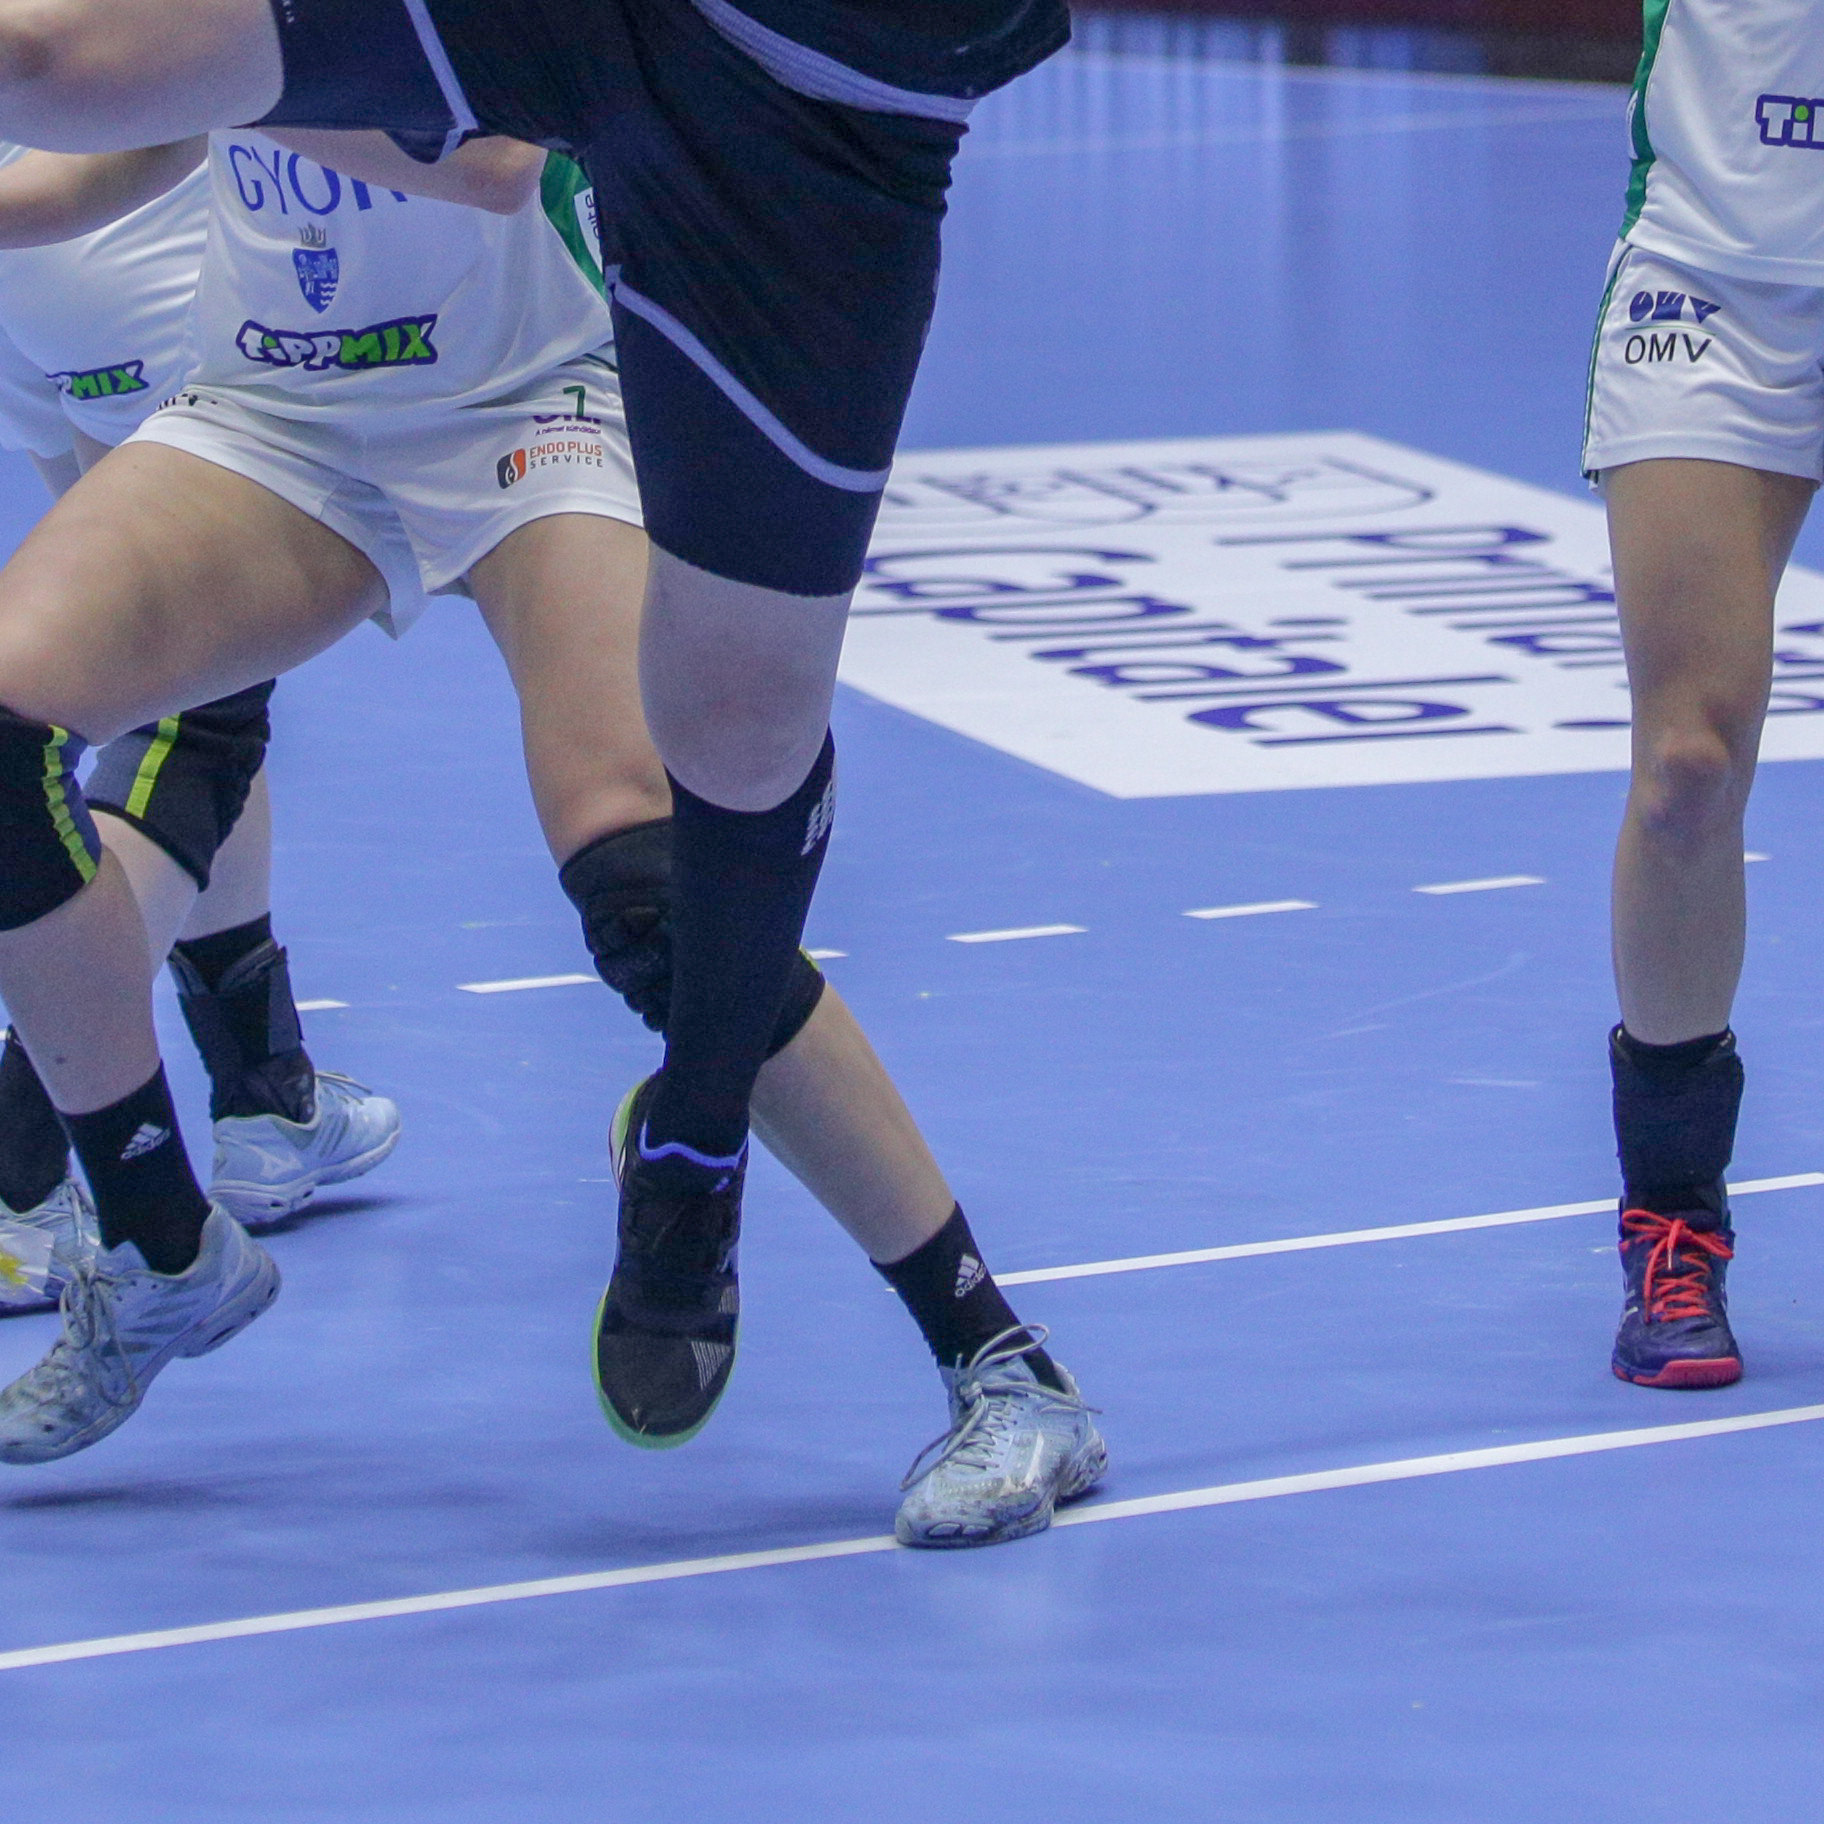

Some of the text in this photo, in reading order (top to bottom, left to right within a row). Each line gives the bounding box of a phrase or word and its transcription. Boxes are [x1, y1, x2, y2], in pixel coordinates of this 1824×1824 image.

[1624, 332, 1713, 365] OMV
[562, 385, 586, 417] 7
[530, 455, 604, 470] SERVICE
